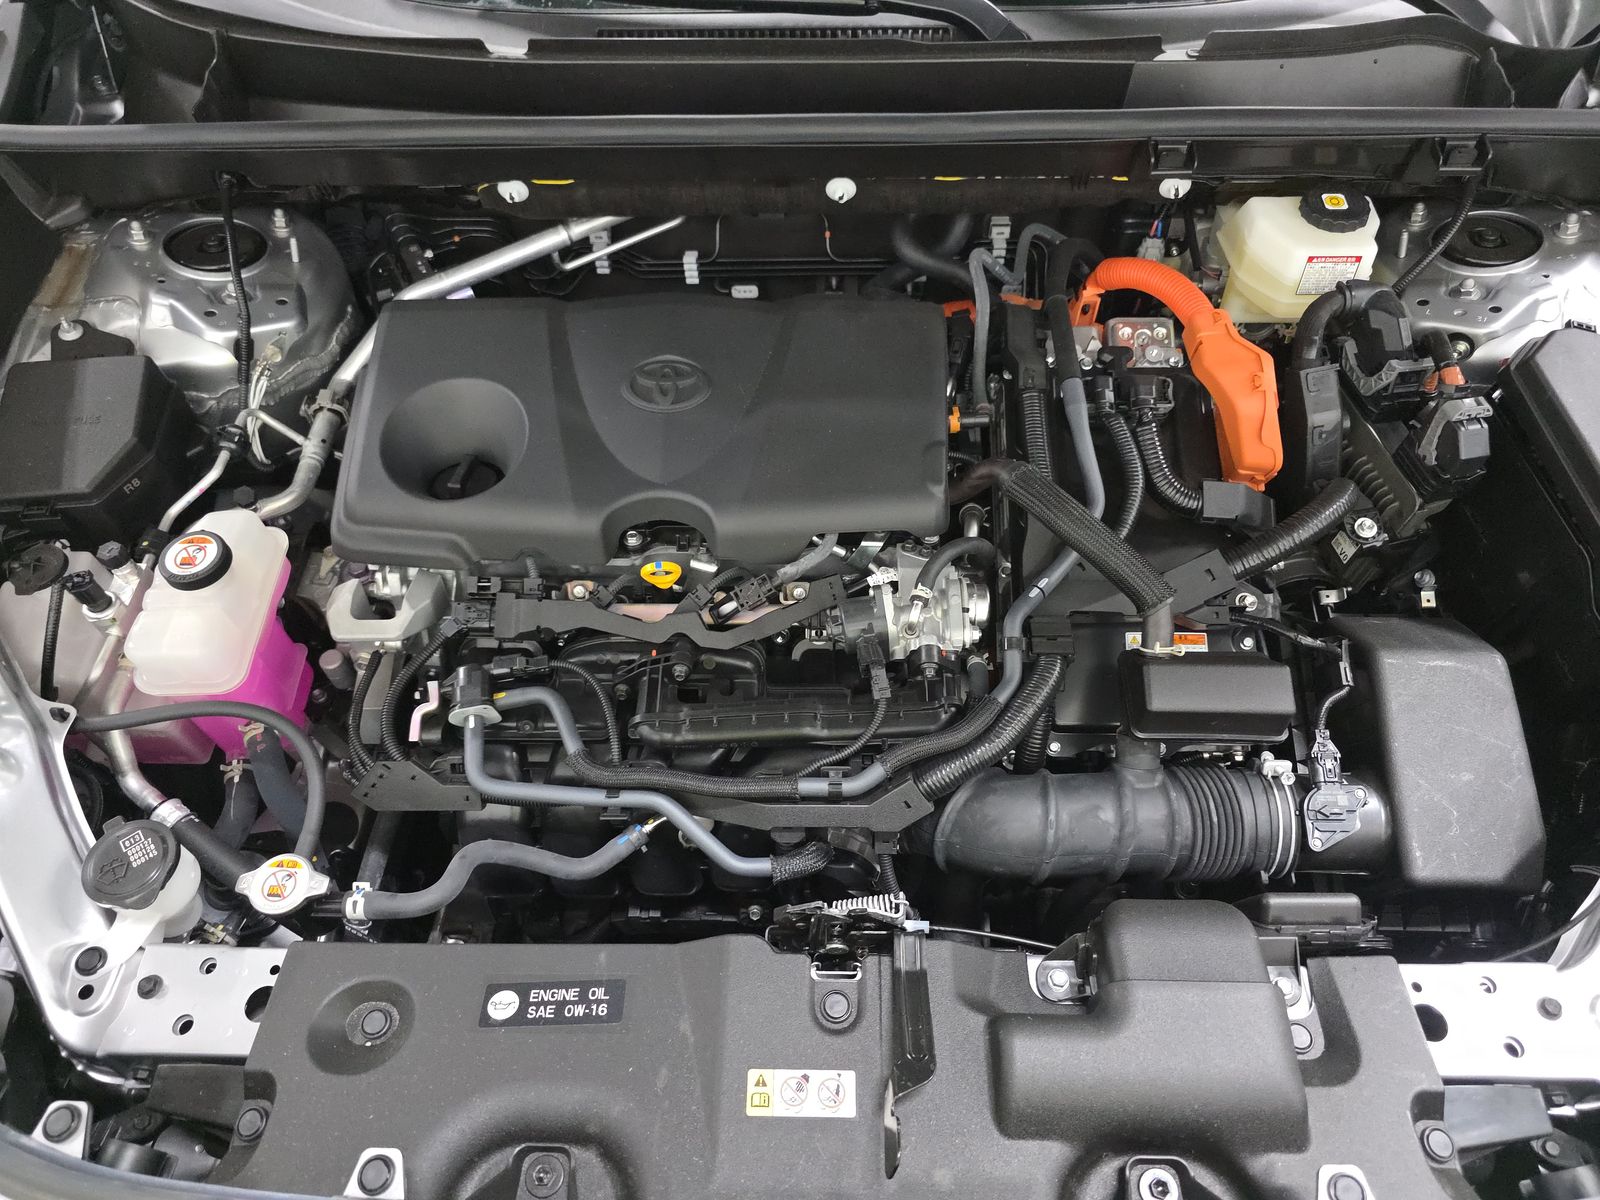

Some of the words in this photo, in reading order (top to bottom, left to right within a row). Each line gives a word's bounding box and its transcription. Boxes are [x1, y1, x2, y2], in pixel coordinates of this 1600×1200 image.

[123, 478, 141, 495] R8
[124, 834, 141, 848] e13
[127, 837, 152, 857] 000127
[131, 849, 158, 868] 000145
[529, 988, 580, 1002] ENGINE
[588, 987, 610, 1000] OIL
[526, 1005, 556, 1019] SAE
[564, 1003, 608, 1017] 0W-16
